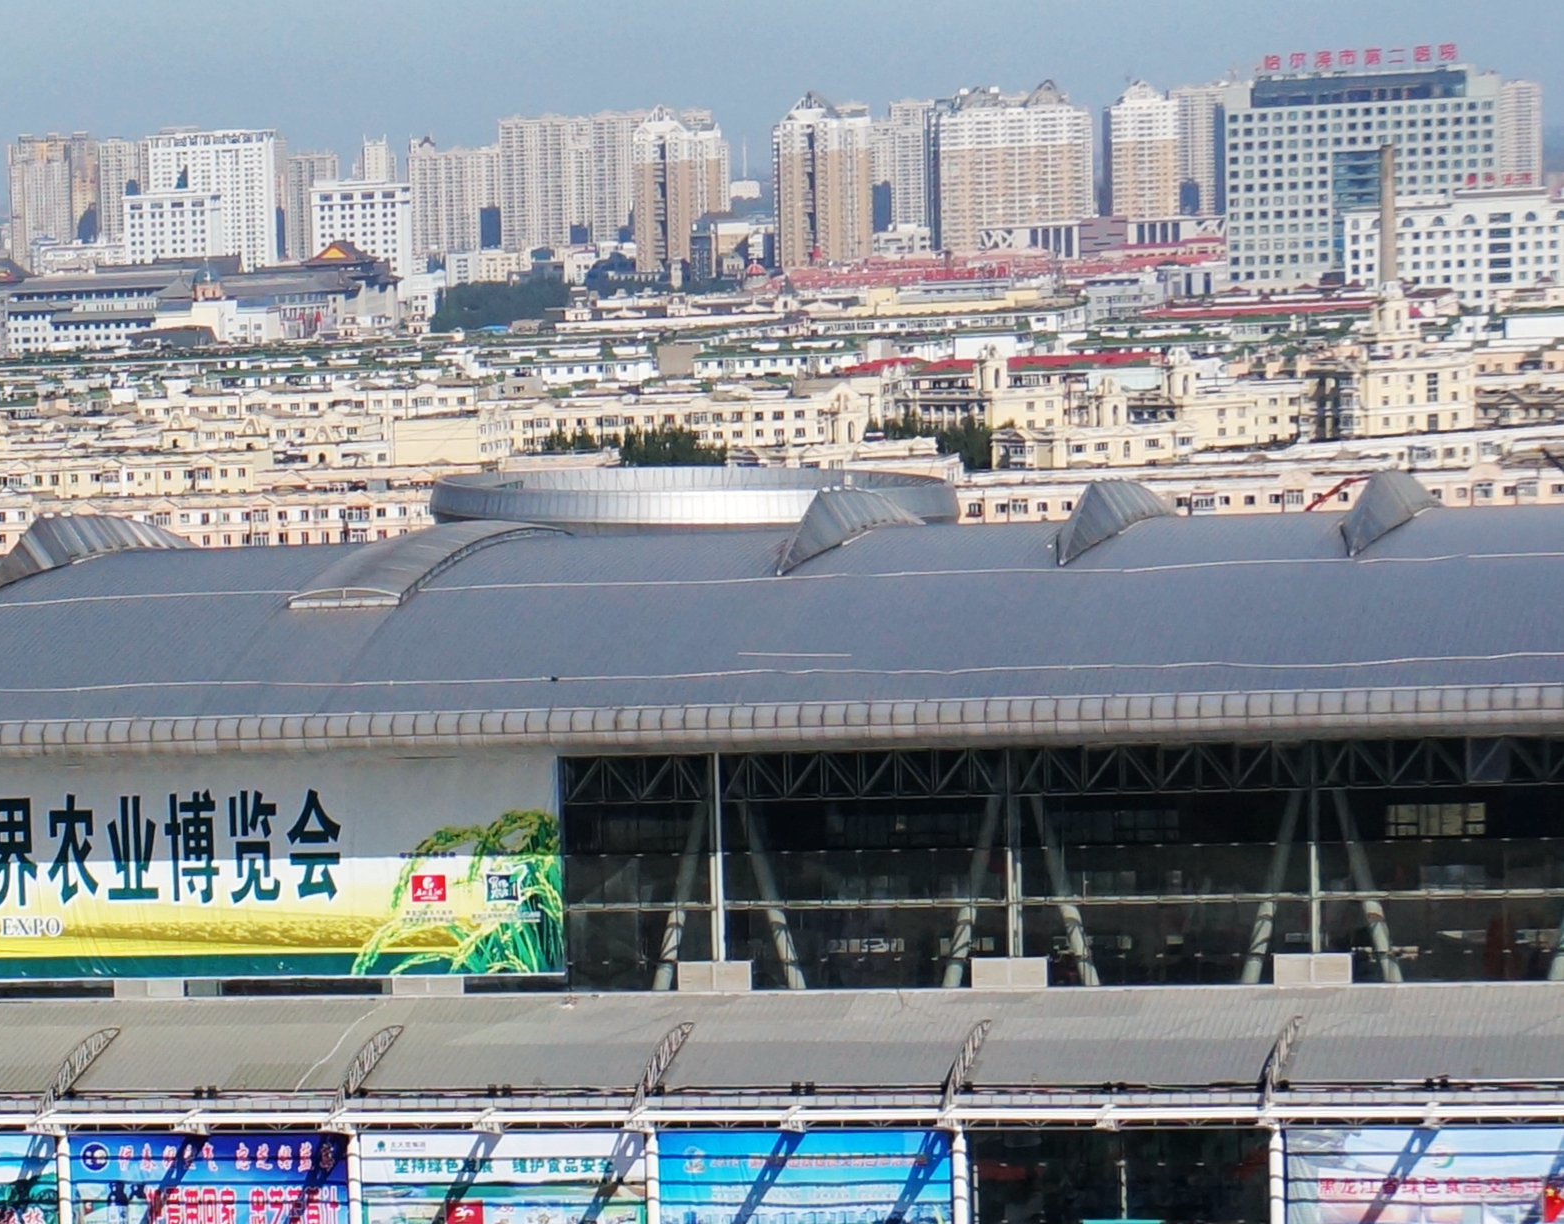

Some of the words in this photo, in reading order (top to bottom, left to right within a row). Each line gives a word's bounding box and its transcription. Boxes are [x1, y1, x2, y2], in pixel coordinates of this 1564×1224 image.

[1264, 43, 1458, 71] 哈尔滨市第二医院
[1, 917, 64, 936] EXPO
[394, 1158, 493, 1174] 坚持绿色发展
[512, 1158, 613, 1174] 维护食品安全
